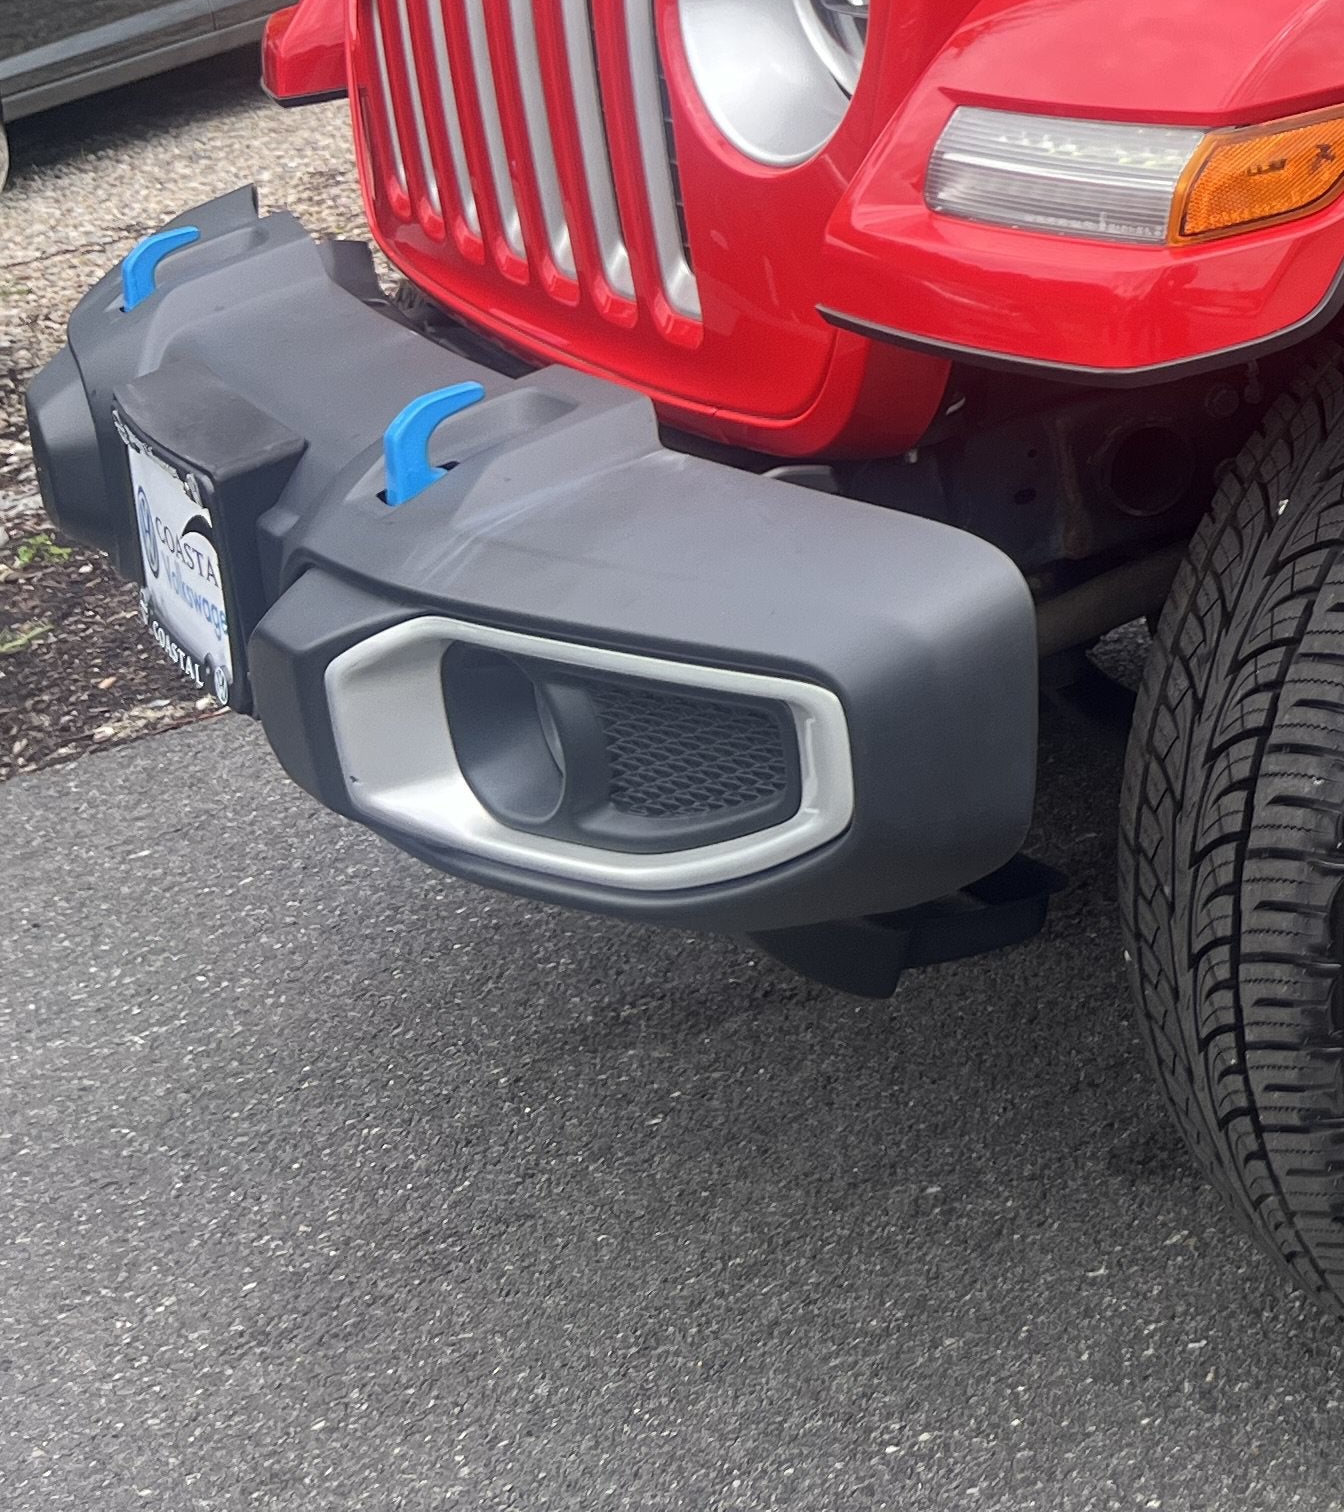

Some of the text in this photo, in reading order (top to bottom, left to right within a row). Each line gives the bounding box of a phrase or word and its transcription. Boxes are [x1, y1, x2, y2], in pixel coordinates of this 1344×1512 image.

[156, 517, 219, 588] COASTA
[162, 550, 228, 641] Volkswage
[152, 620, 204, 688] COASTAL
